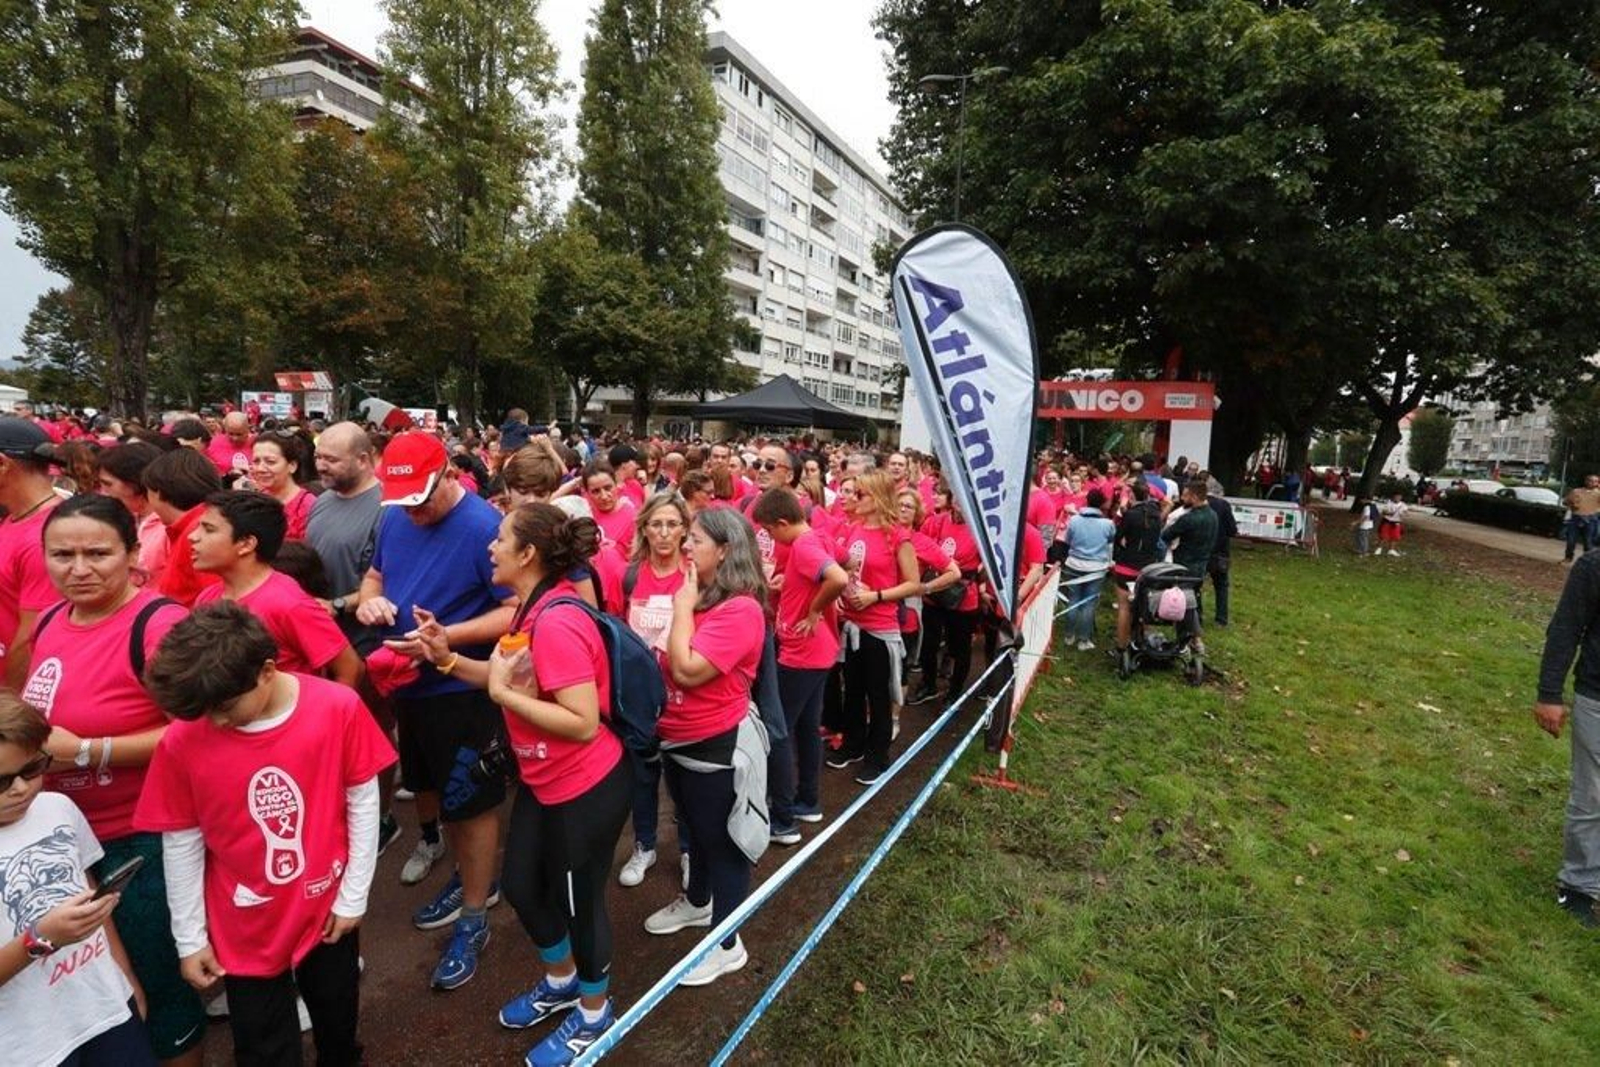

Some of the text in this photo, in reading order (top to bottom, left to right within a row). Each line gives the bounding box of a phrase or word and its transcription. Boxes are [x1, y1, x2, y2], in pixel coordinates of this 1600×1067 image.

[260, 774, 279, 788] VI
[257, 791, 293, 805] VIGO
[49, 932, 105, 986] DUDE
